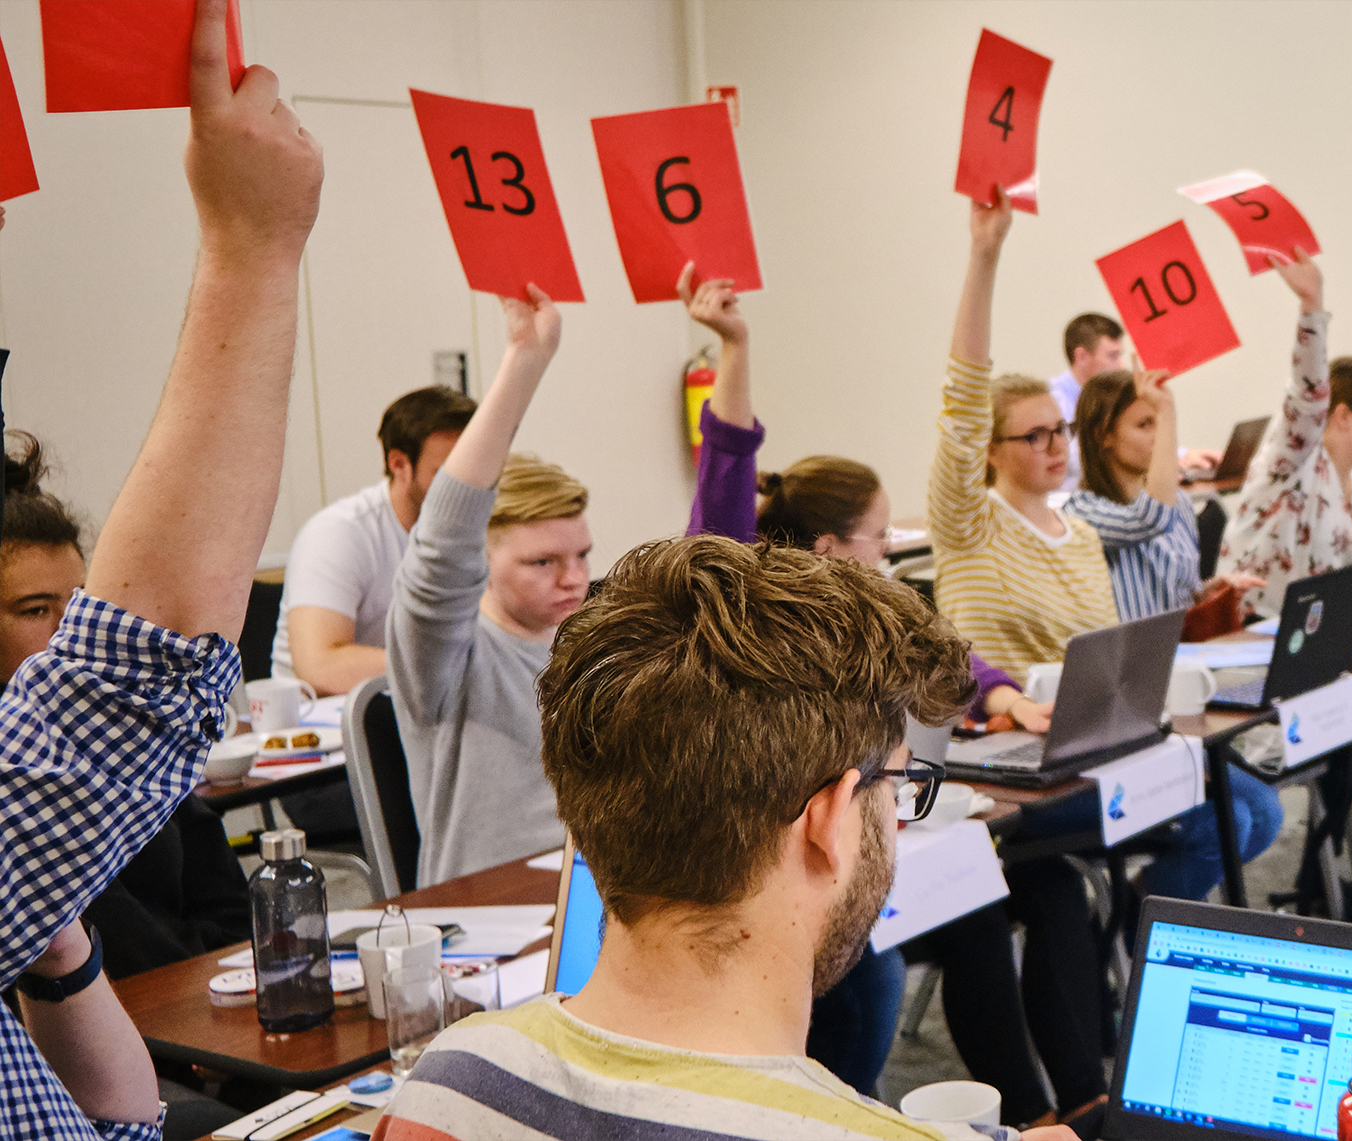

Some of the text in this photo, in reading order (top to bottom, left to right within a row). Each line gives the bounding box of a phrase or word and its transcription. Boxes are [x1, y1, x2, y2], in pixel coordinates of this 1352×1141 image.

[989, 86, 1015, 141] 4
[451, 146, 535, 216] 13
[655, 156, 702, 224] 6
[1231, 192, 1269, 220] 5
[1129, 260, 1197, 323] 10
